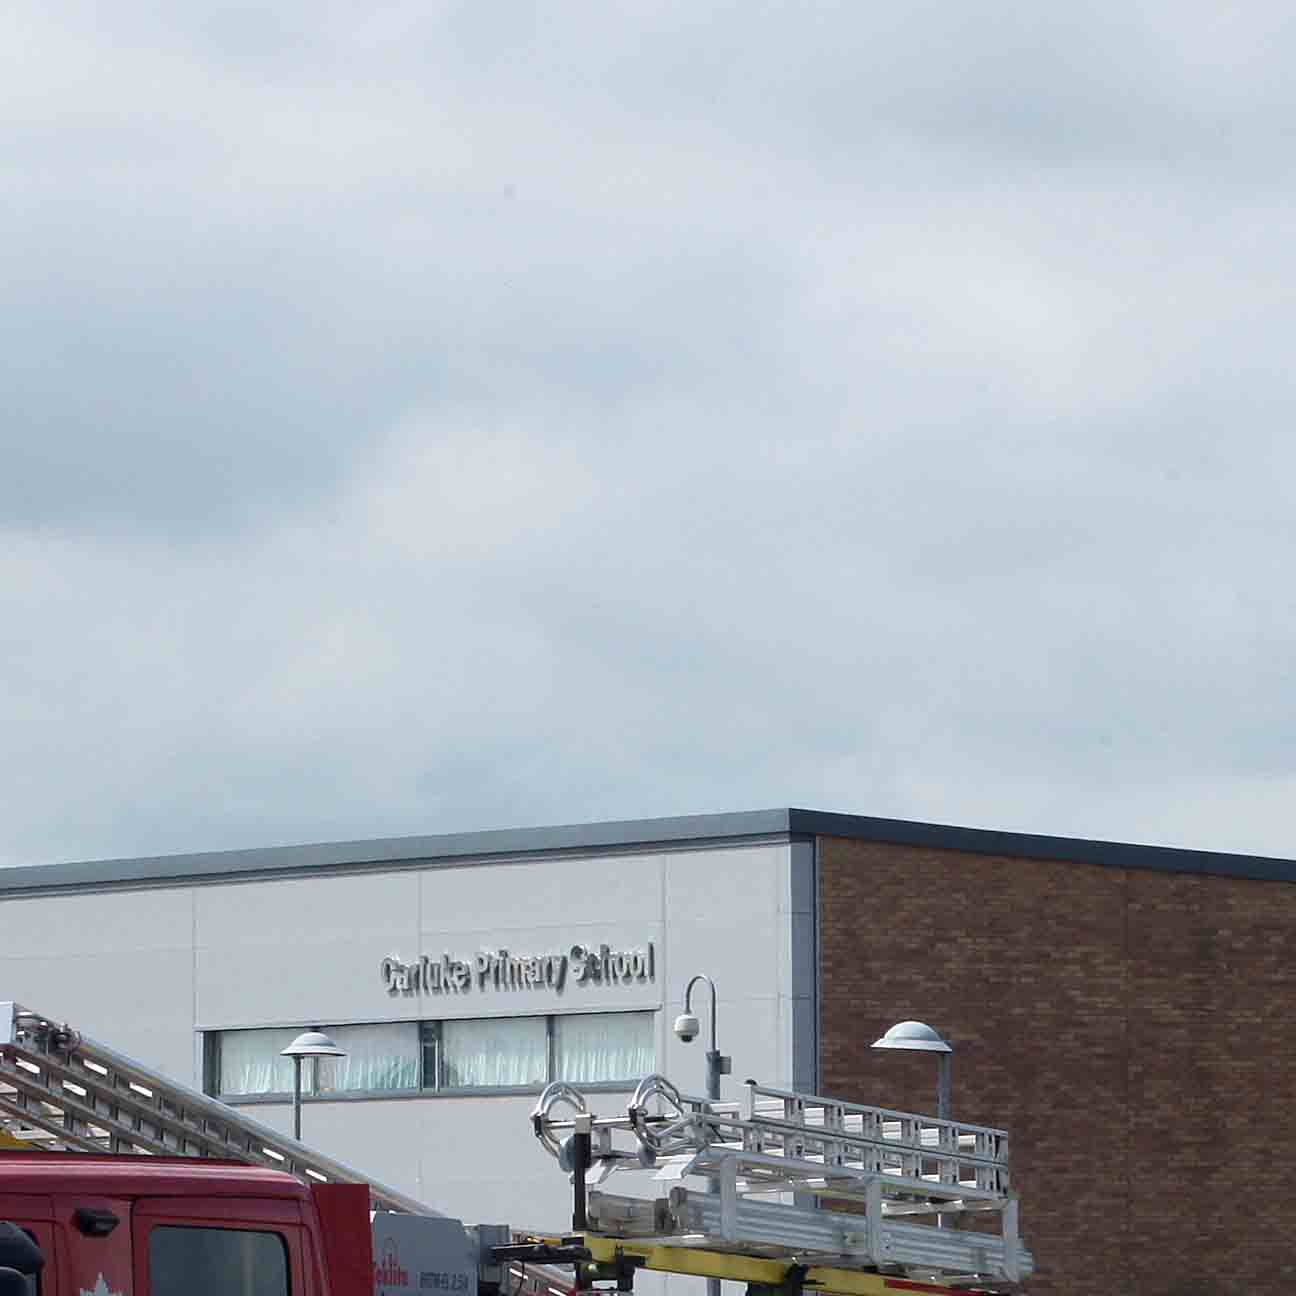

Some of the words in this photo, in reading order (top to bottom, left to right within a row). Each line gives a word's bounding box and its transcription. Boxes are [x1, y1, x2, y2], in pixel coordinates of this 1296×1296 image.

[381, 953, 471, 996] Carluke
[476, 949, 568, 996] Primary
[570, 942, 655, 984] School
